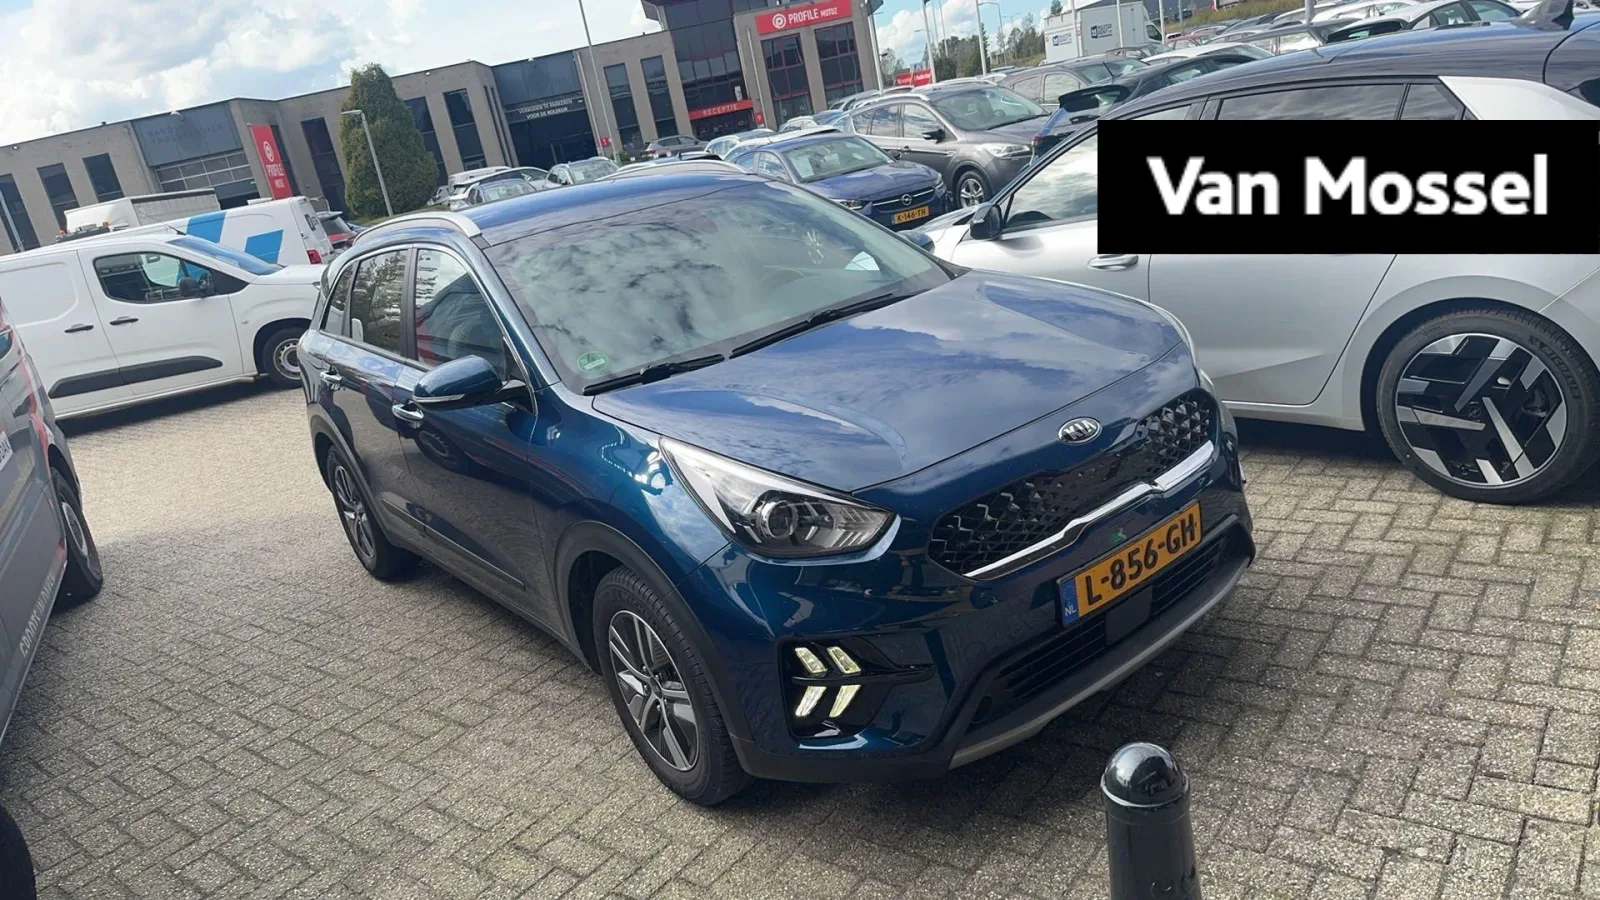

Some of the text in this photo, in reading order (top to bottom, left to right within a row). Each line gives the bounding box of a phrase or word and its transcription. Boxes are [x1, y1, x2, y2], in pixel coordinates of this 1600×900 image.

[788, 8, 819, 25] PROFILE
[547, 107, 568, 115] ROLDEUR
[702, 103, 737, 117] RECEPTIE
[897, 208, 926, 223] K-146-TH
[1065, 420, 1097, 440] KIA
[1086, 513, 1196, 606] L-856-GH
[1065, 604, 1077, 616] NL
